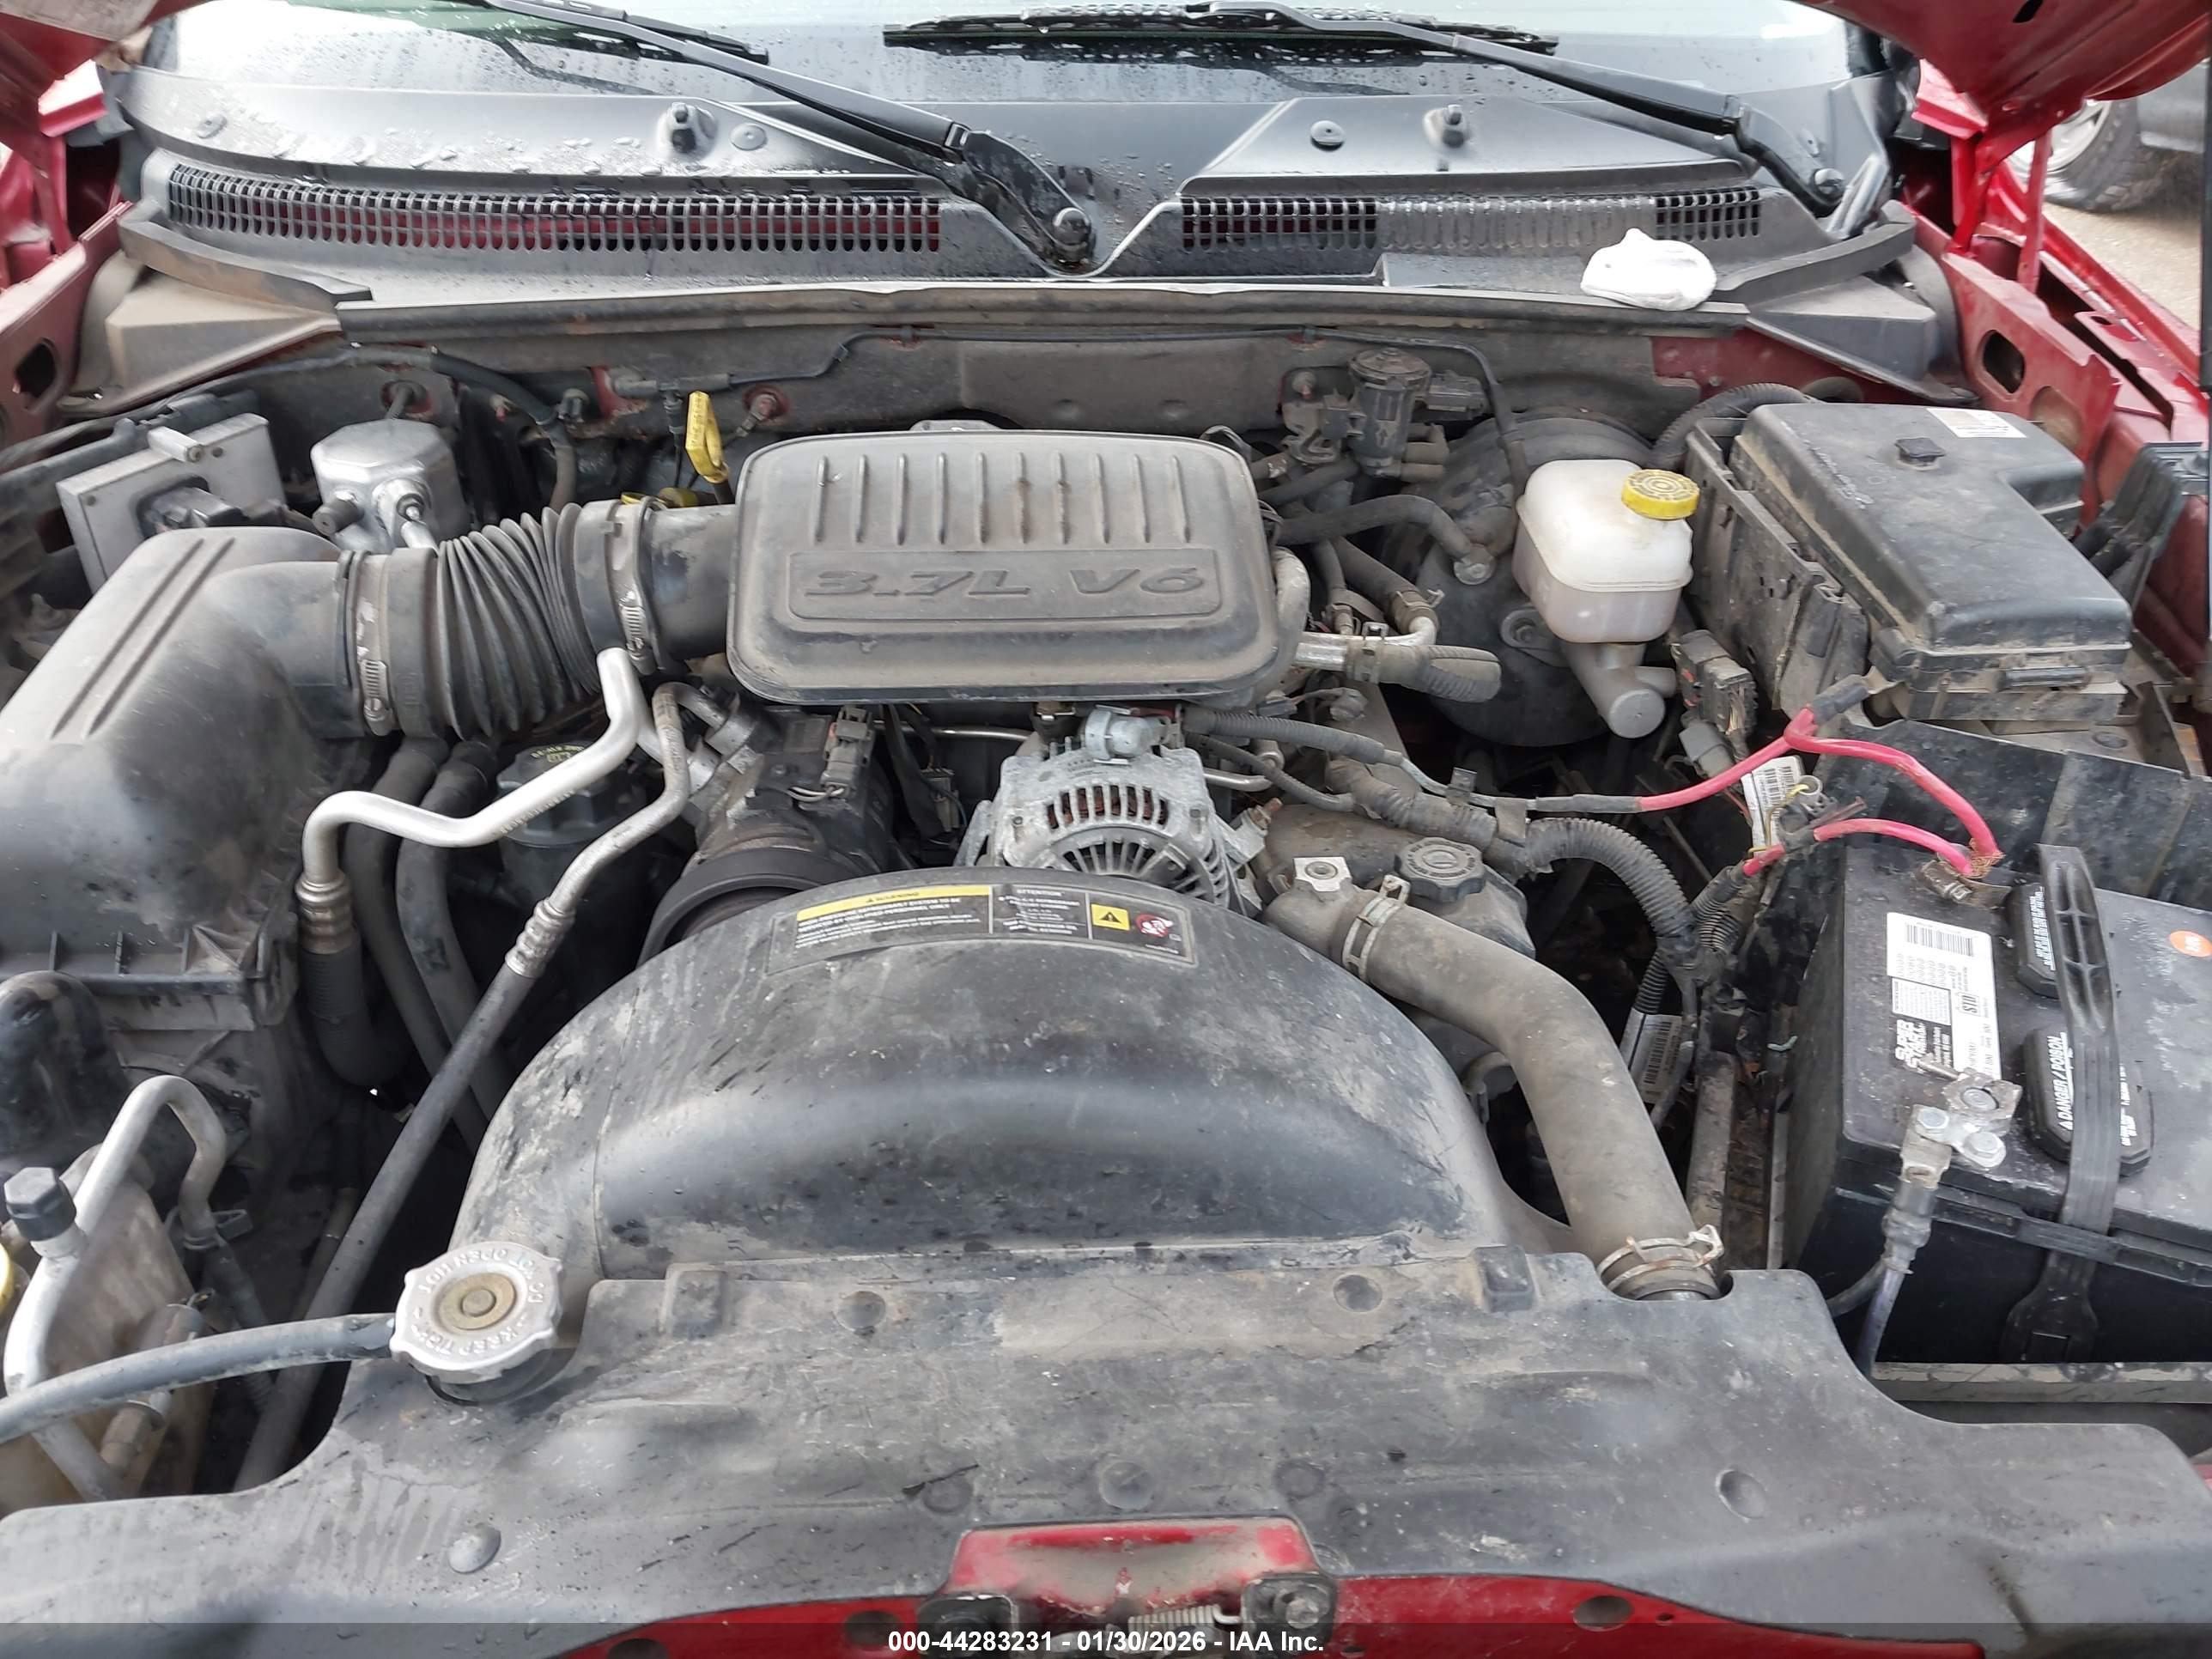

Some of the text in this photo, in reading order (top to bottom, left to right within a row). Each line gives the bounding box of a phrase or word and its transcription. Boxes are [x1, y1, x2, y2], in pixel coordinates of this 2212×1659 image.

[805, 567, 1204, 597] 3.7L V6
[1895, 1019, 1914, 1060] SUPER
[2047, 1036, 2066, 1072] POISON
[2053, 1079, 2074, 1121] DANGER
[453, 1249, 508, 1267] OPEN
